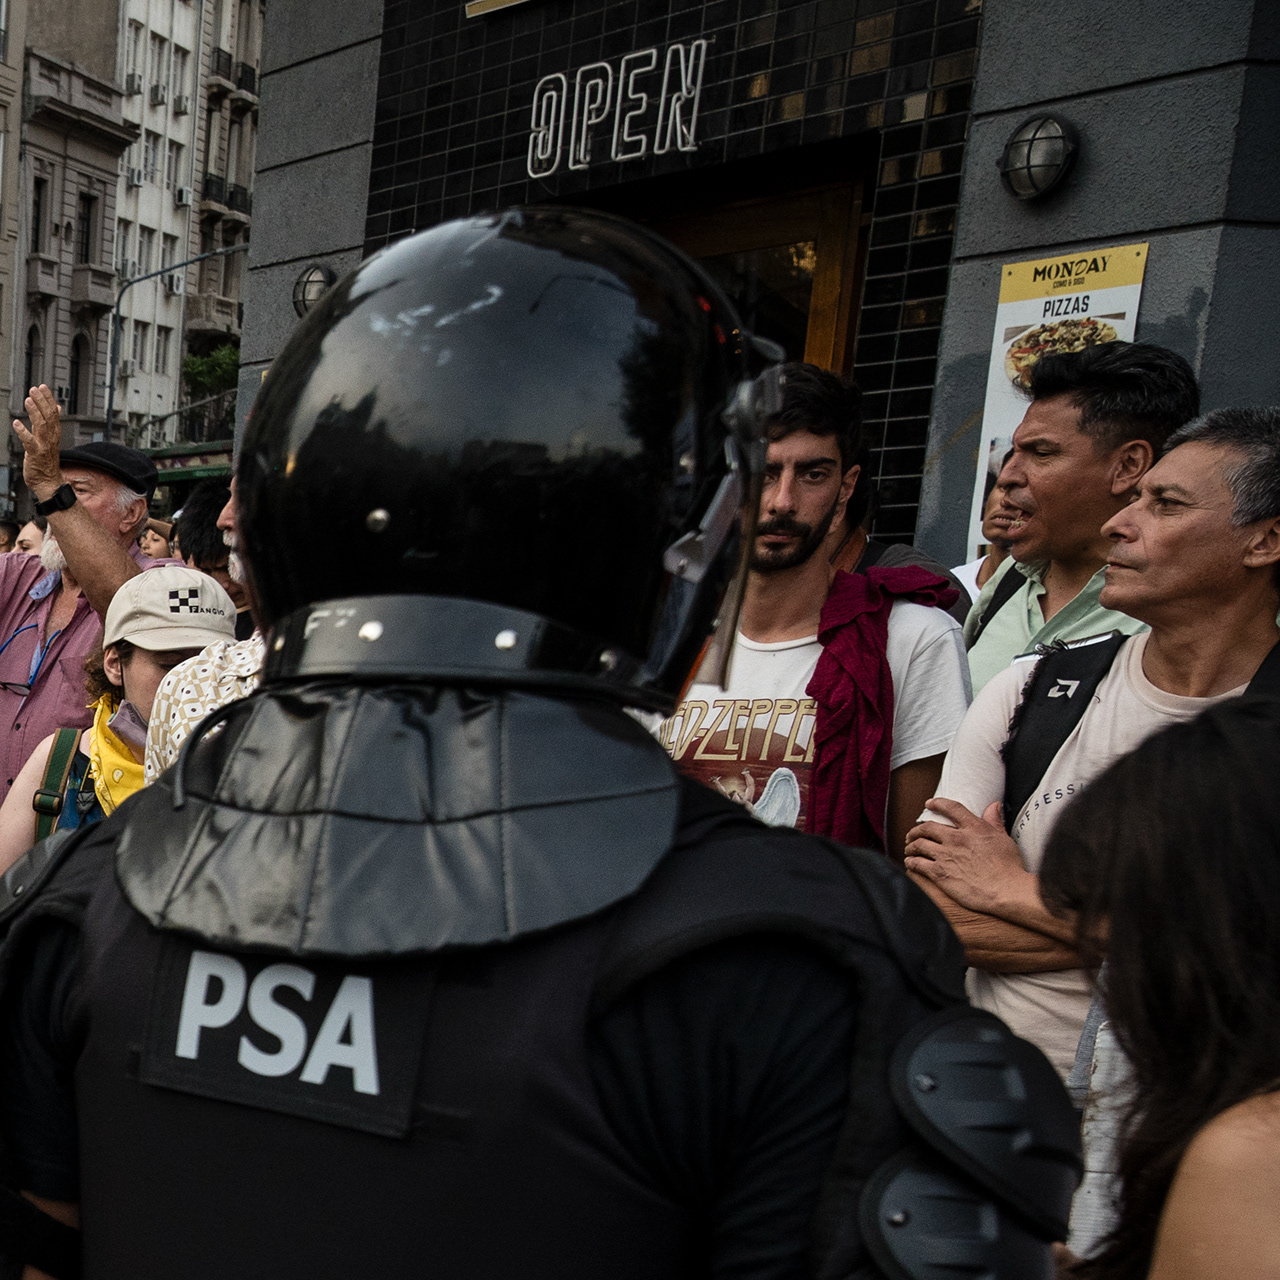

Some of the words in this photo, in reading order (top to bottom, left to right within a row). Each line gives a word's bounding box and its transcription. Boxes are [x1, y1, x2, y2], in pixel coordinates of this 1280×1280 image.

[527, 39, 707, 179] OPEN
[1033, 254, 1112, 282] MONDAY
[1042, 295, 1090, 318] PIZZAS
[175, 949, 381, 1096] PSA
